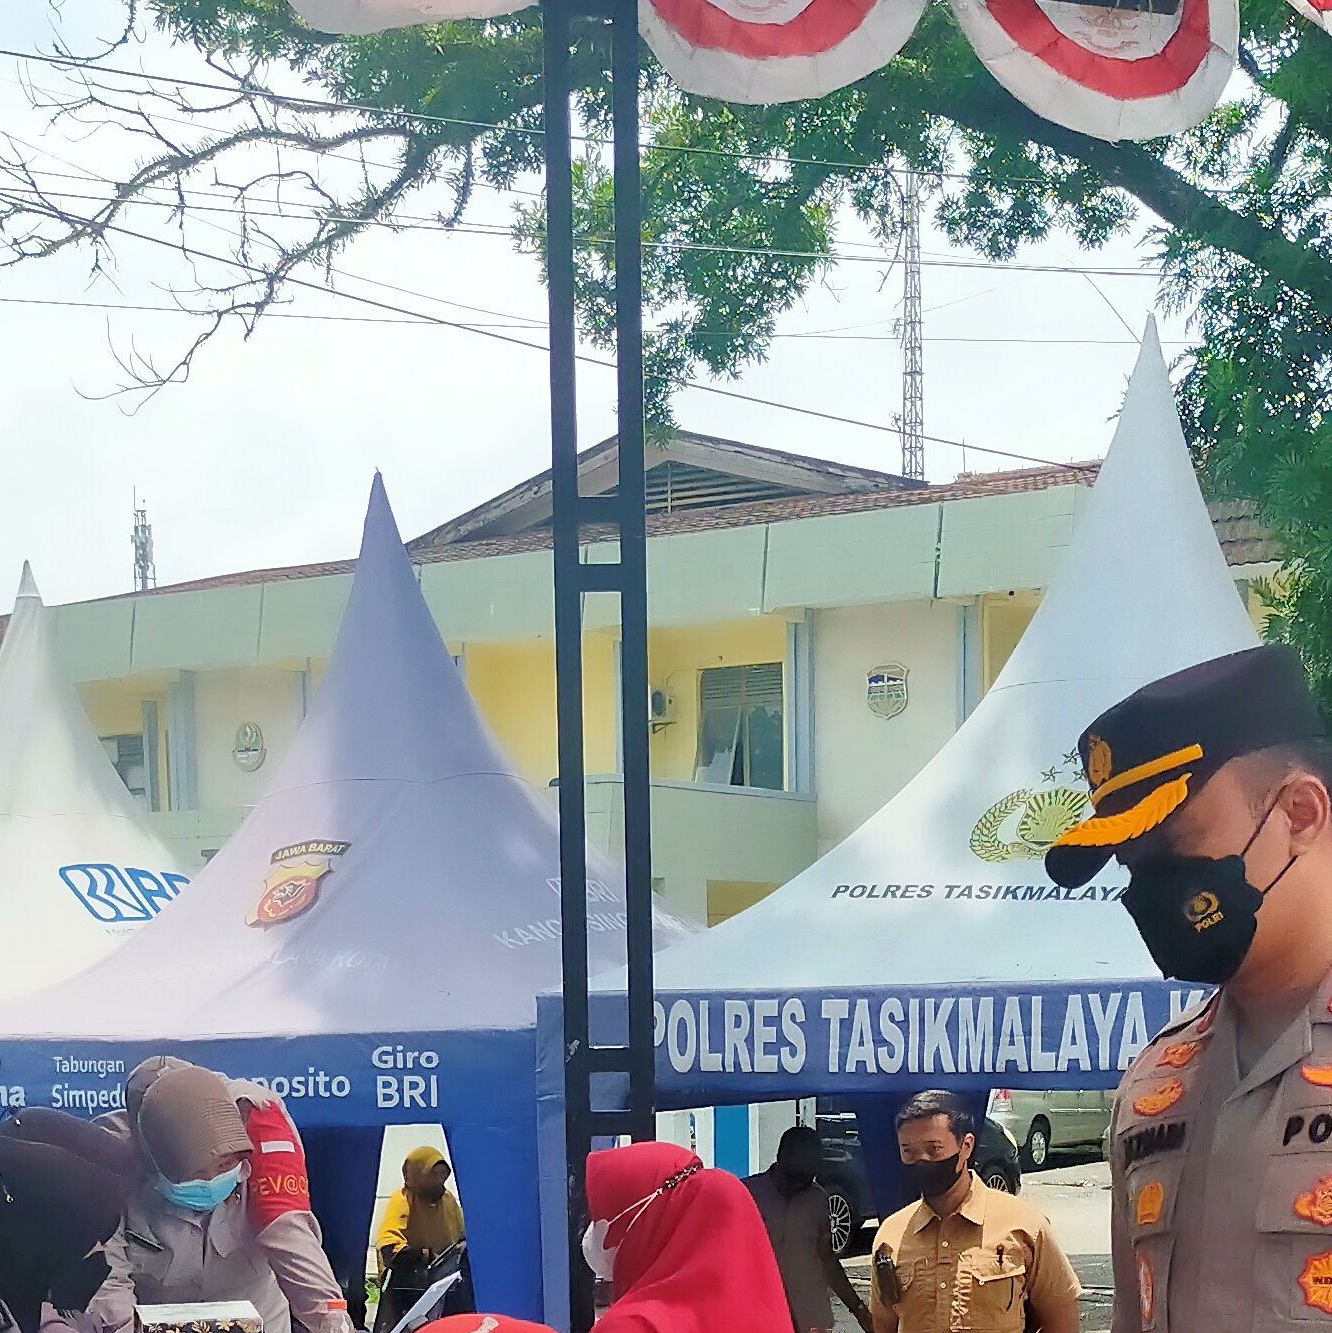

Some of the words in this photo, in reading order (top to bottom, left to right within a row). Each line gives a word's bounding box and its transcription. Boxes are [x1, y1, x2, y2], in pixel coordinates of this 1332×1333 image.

[307, 843, 346, 854] BARAT
[831, 885, 934, 899] POLRES
[944, 884, 1130, 902] TASIKMALAYA
[821, 991, 1147, 1074] TASIKMALAYA
[54, 1057, 124, 1078] Tabungan
[372, 1045, 440, 1069] Giro
[376, 1074, 438, 1108] BRI
